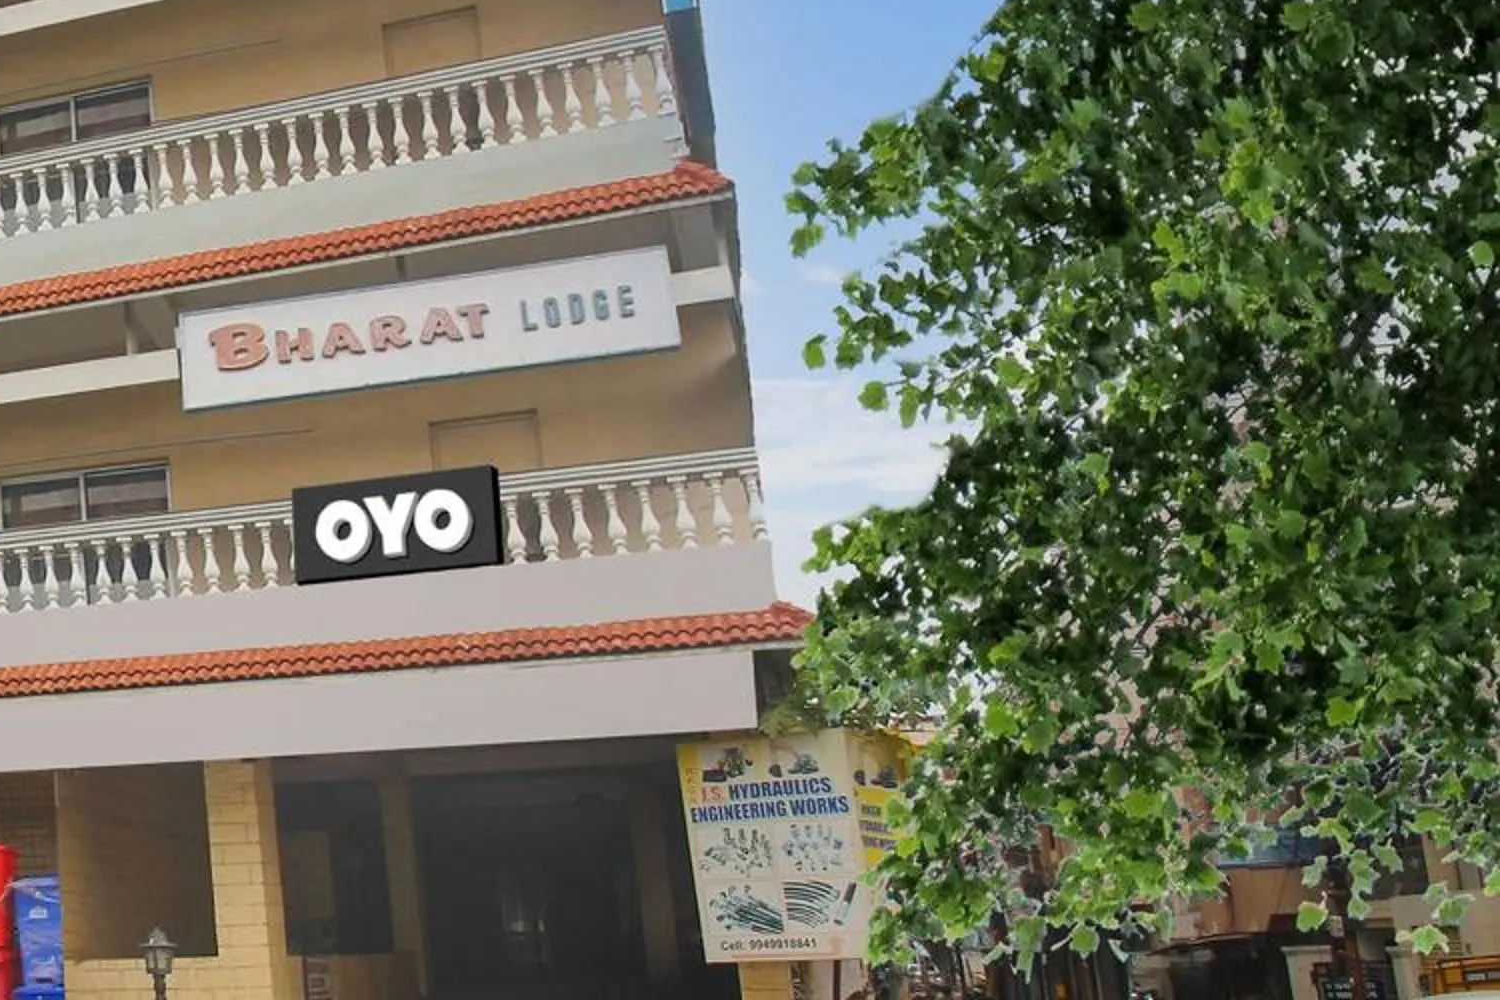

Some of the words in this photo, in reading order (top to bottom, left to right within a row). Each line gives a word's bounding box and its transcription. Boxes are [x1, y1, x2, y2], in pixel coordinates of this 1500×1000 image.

[209, 302, 490, 372] BHARAT
[520, 284, 637, 332] LODGE
[315, 489, 473, 564] OYO
[691, 801, 787, 824] ENGINEERING
[789, 796, 849, 816] WORKS
[728, 777, 832, 801] HYDRAULICS
